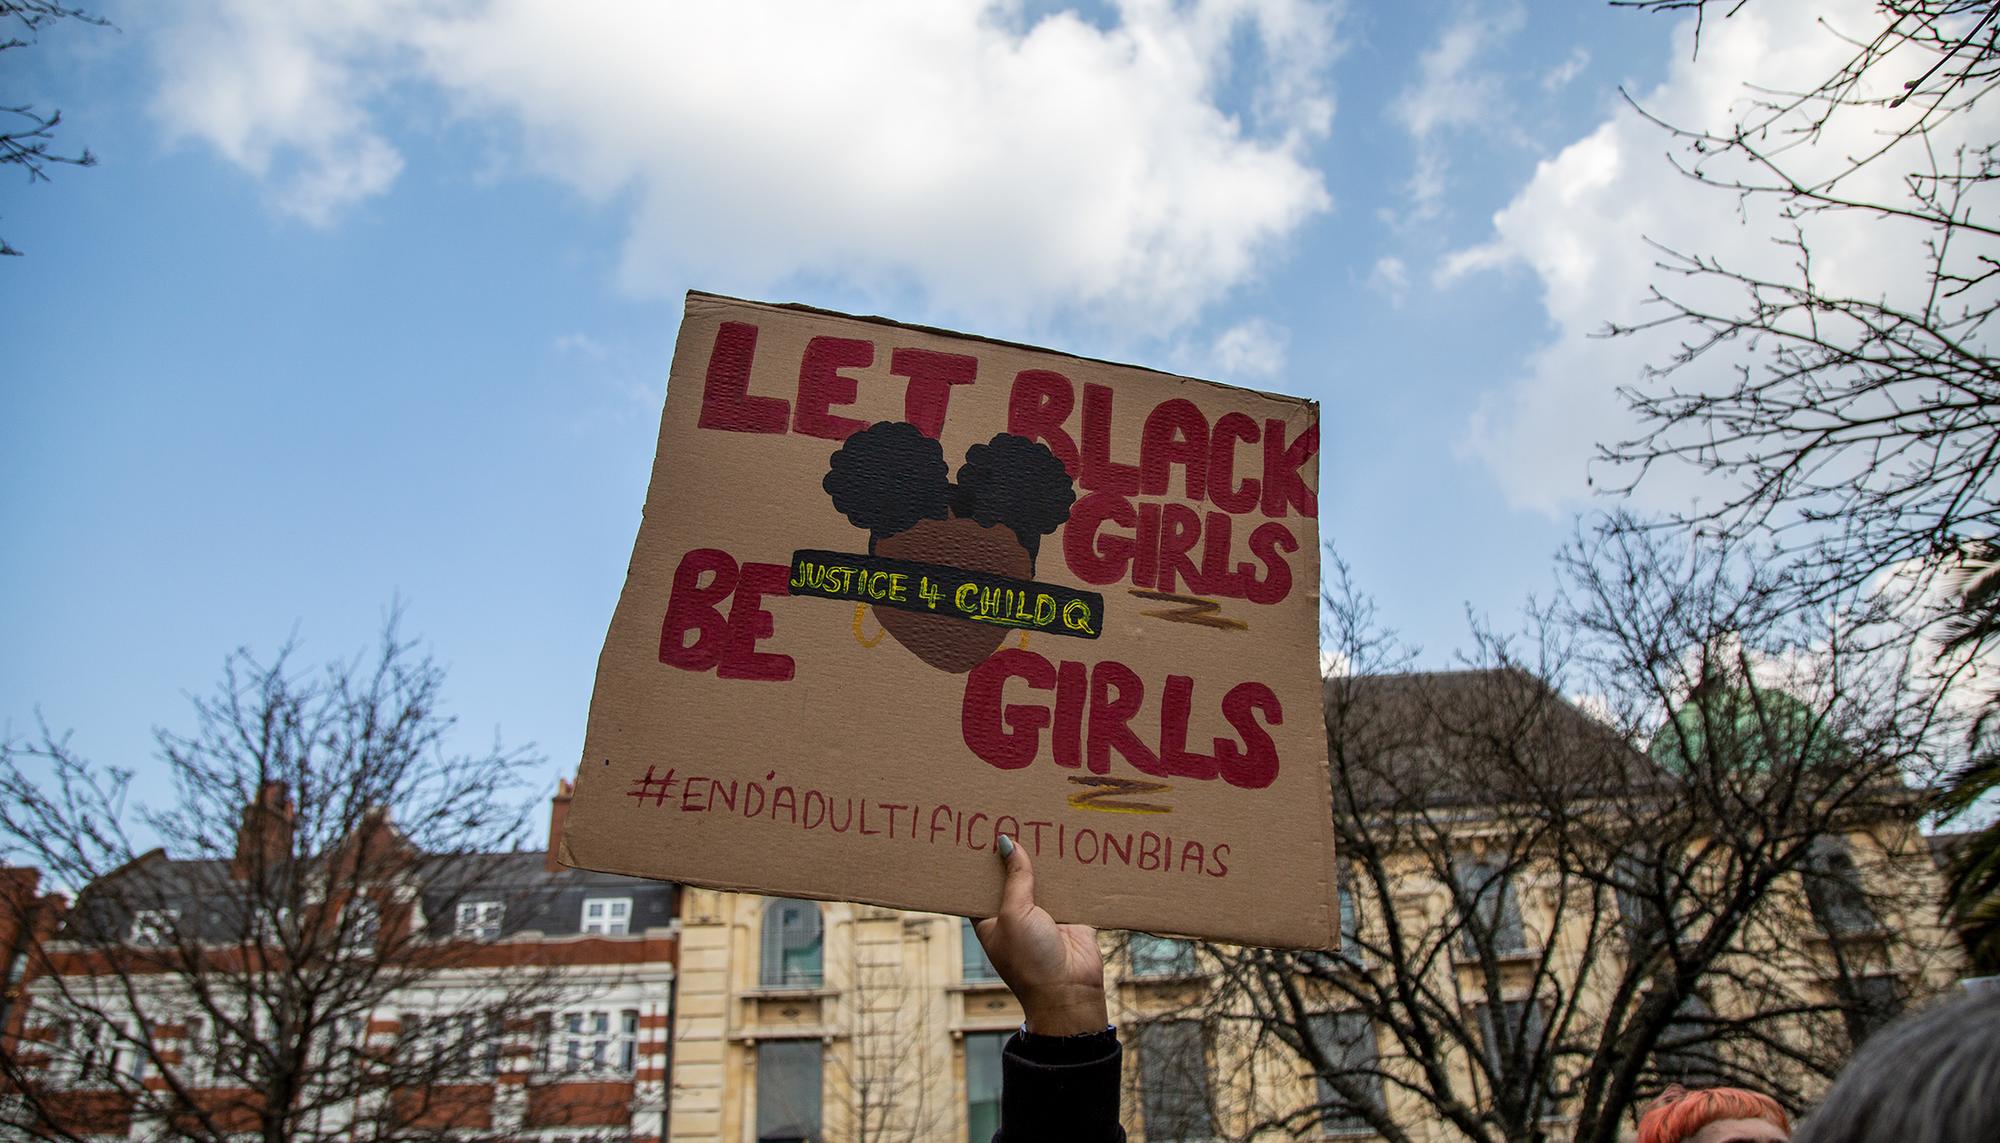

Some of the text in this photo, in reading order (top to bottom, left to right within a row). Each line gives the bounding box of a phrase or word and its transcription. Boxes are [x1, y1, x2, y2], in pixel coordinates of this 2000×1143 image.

[698, 320, 1320, 518] LET BLACK
[659, 548, 796, 682] BE
[791, 560, 1096, 635] JUSTICE 4 CHILD Q
[1062, 492, 1299, 605] GIRLS
[962, 647, 1284, 788] GIRLS
